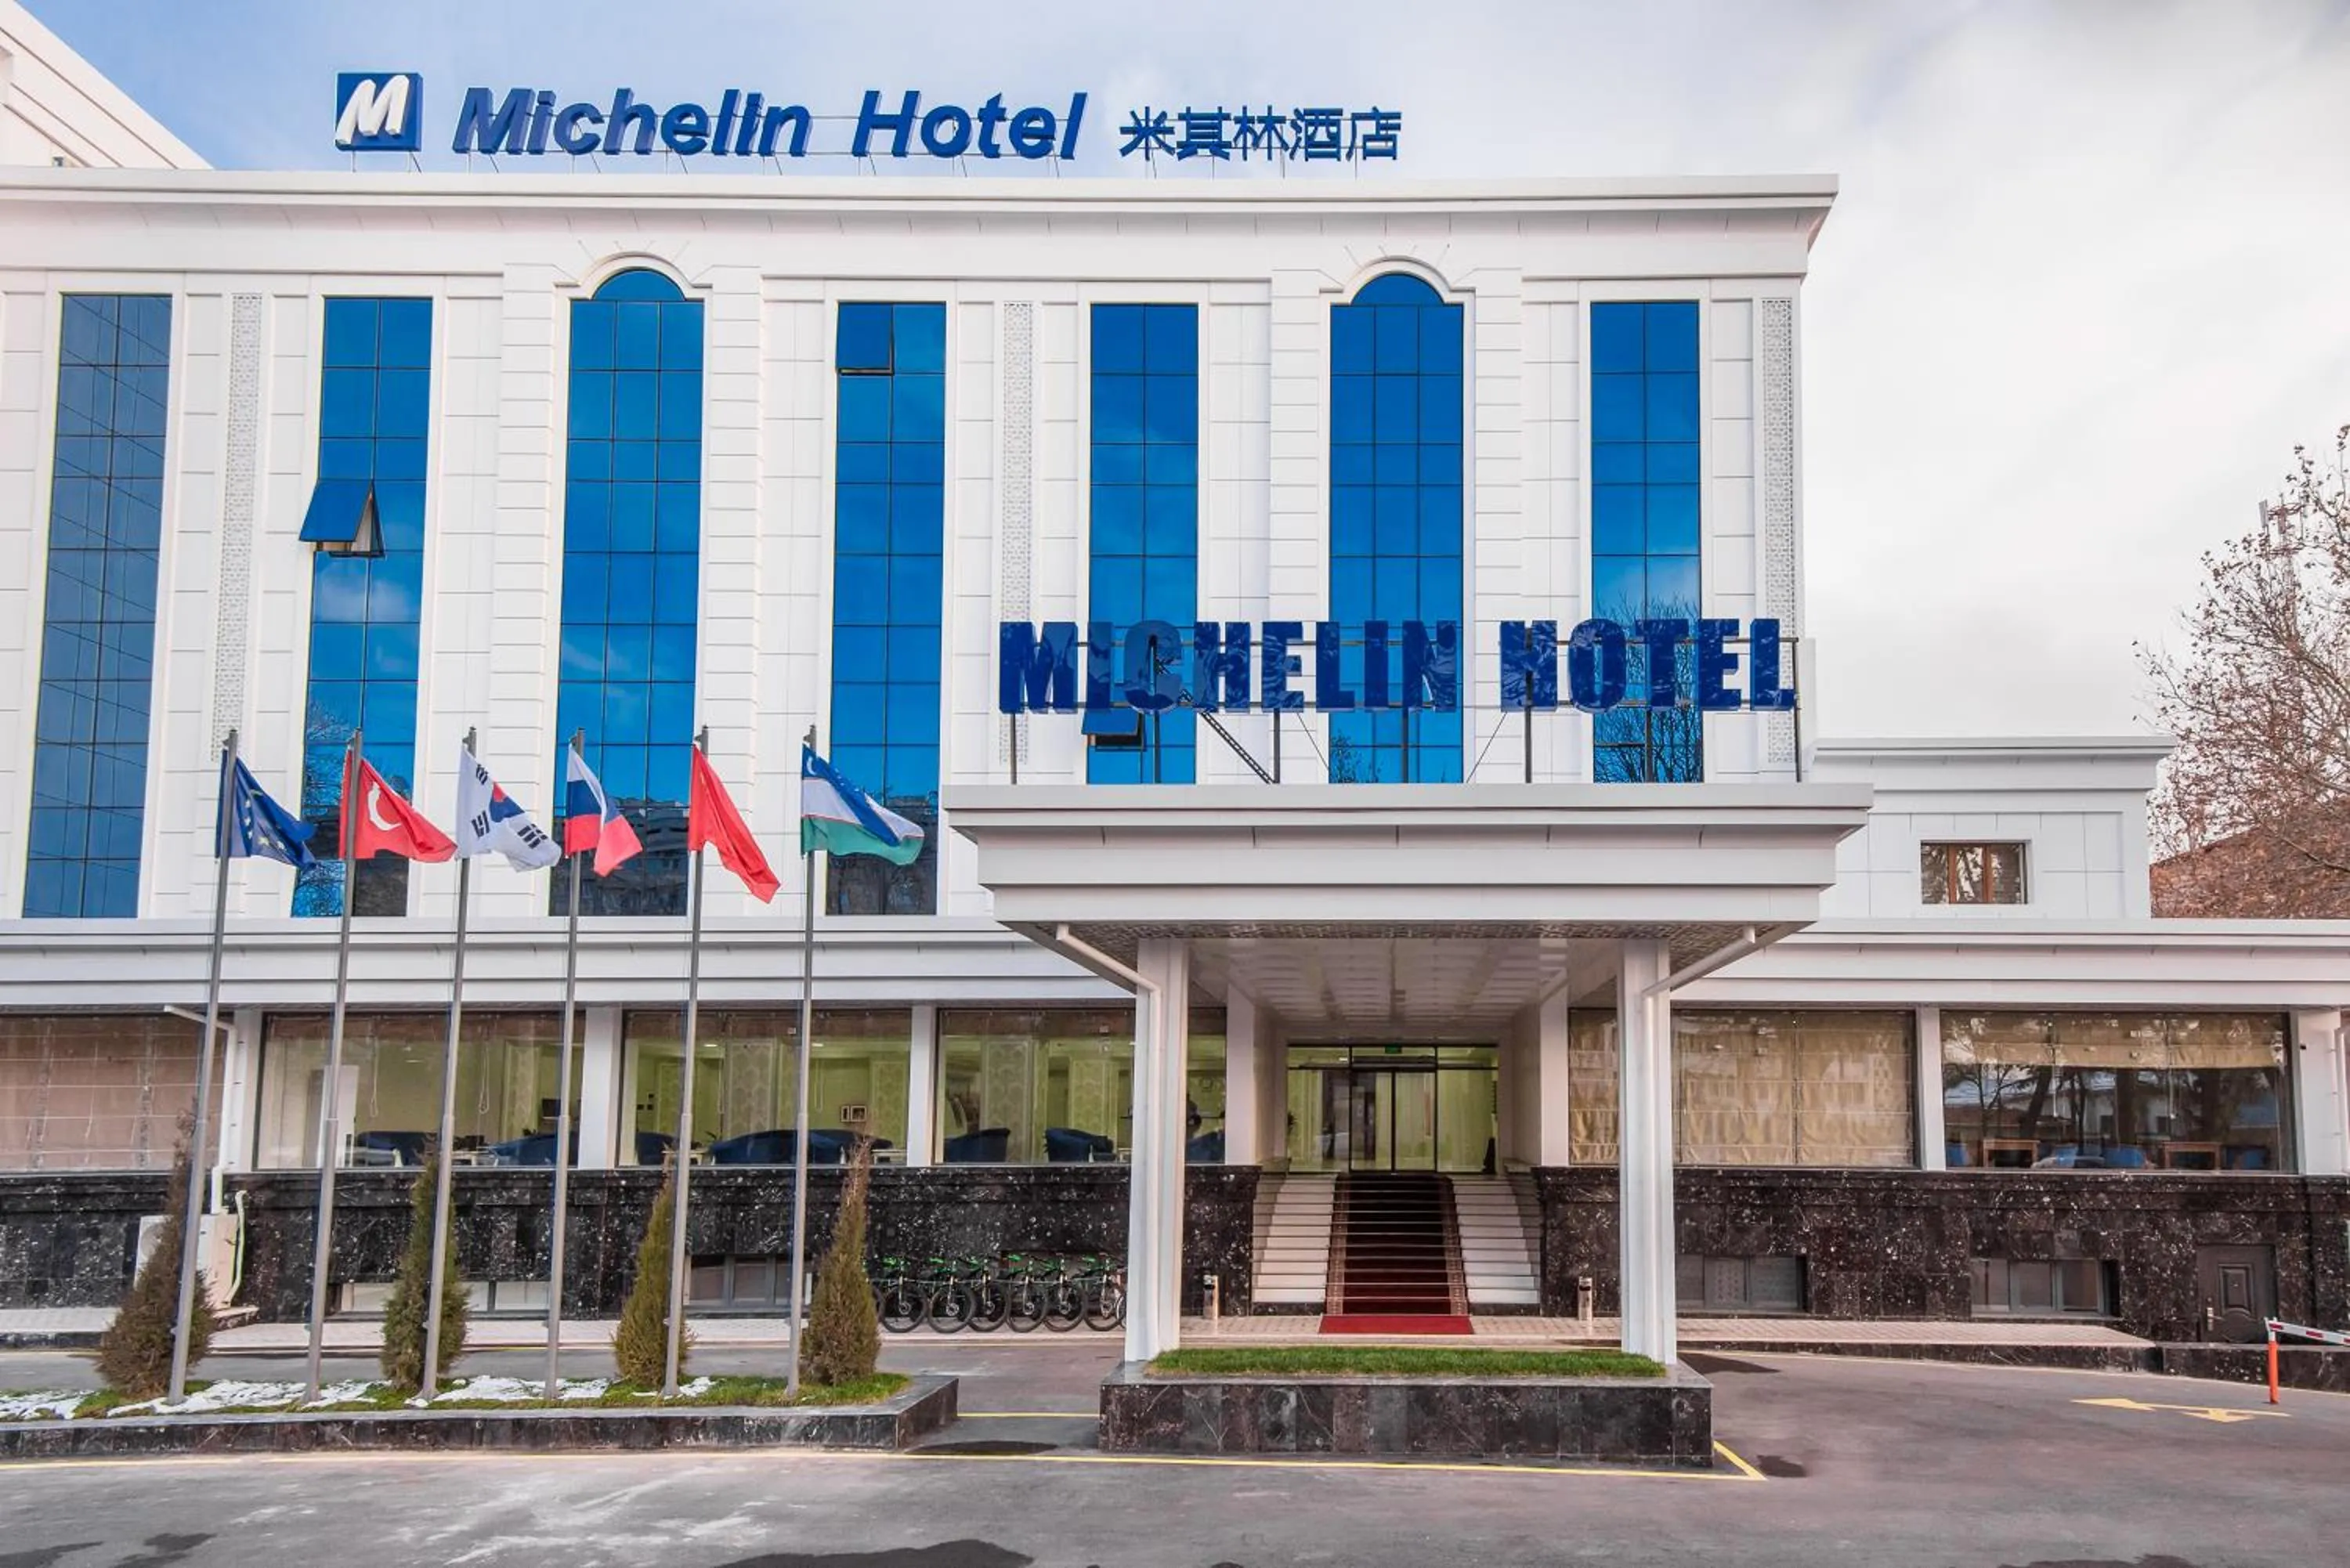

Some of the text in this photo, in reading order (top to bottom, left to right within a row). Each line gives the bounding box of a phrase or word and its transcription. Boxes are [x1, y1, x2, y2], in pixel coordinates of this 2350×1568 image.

[453, 88, 1087, 160] Michelin Hotel
[1119, 105, 1401, 161] 米其林酒店
[999, 618, 1796, 714] MICHELIN HOTEL
